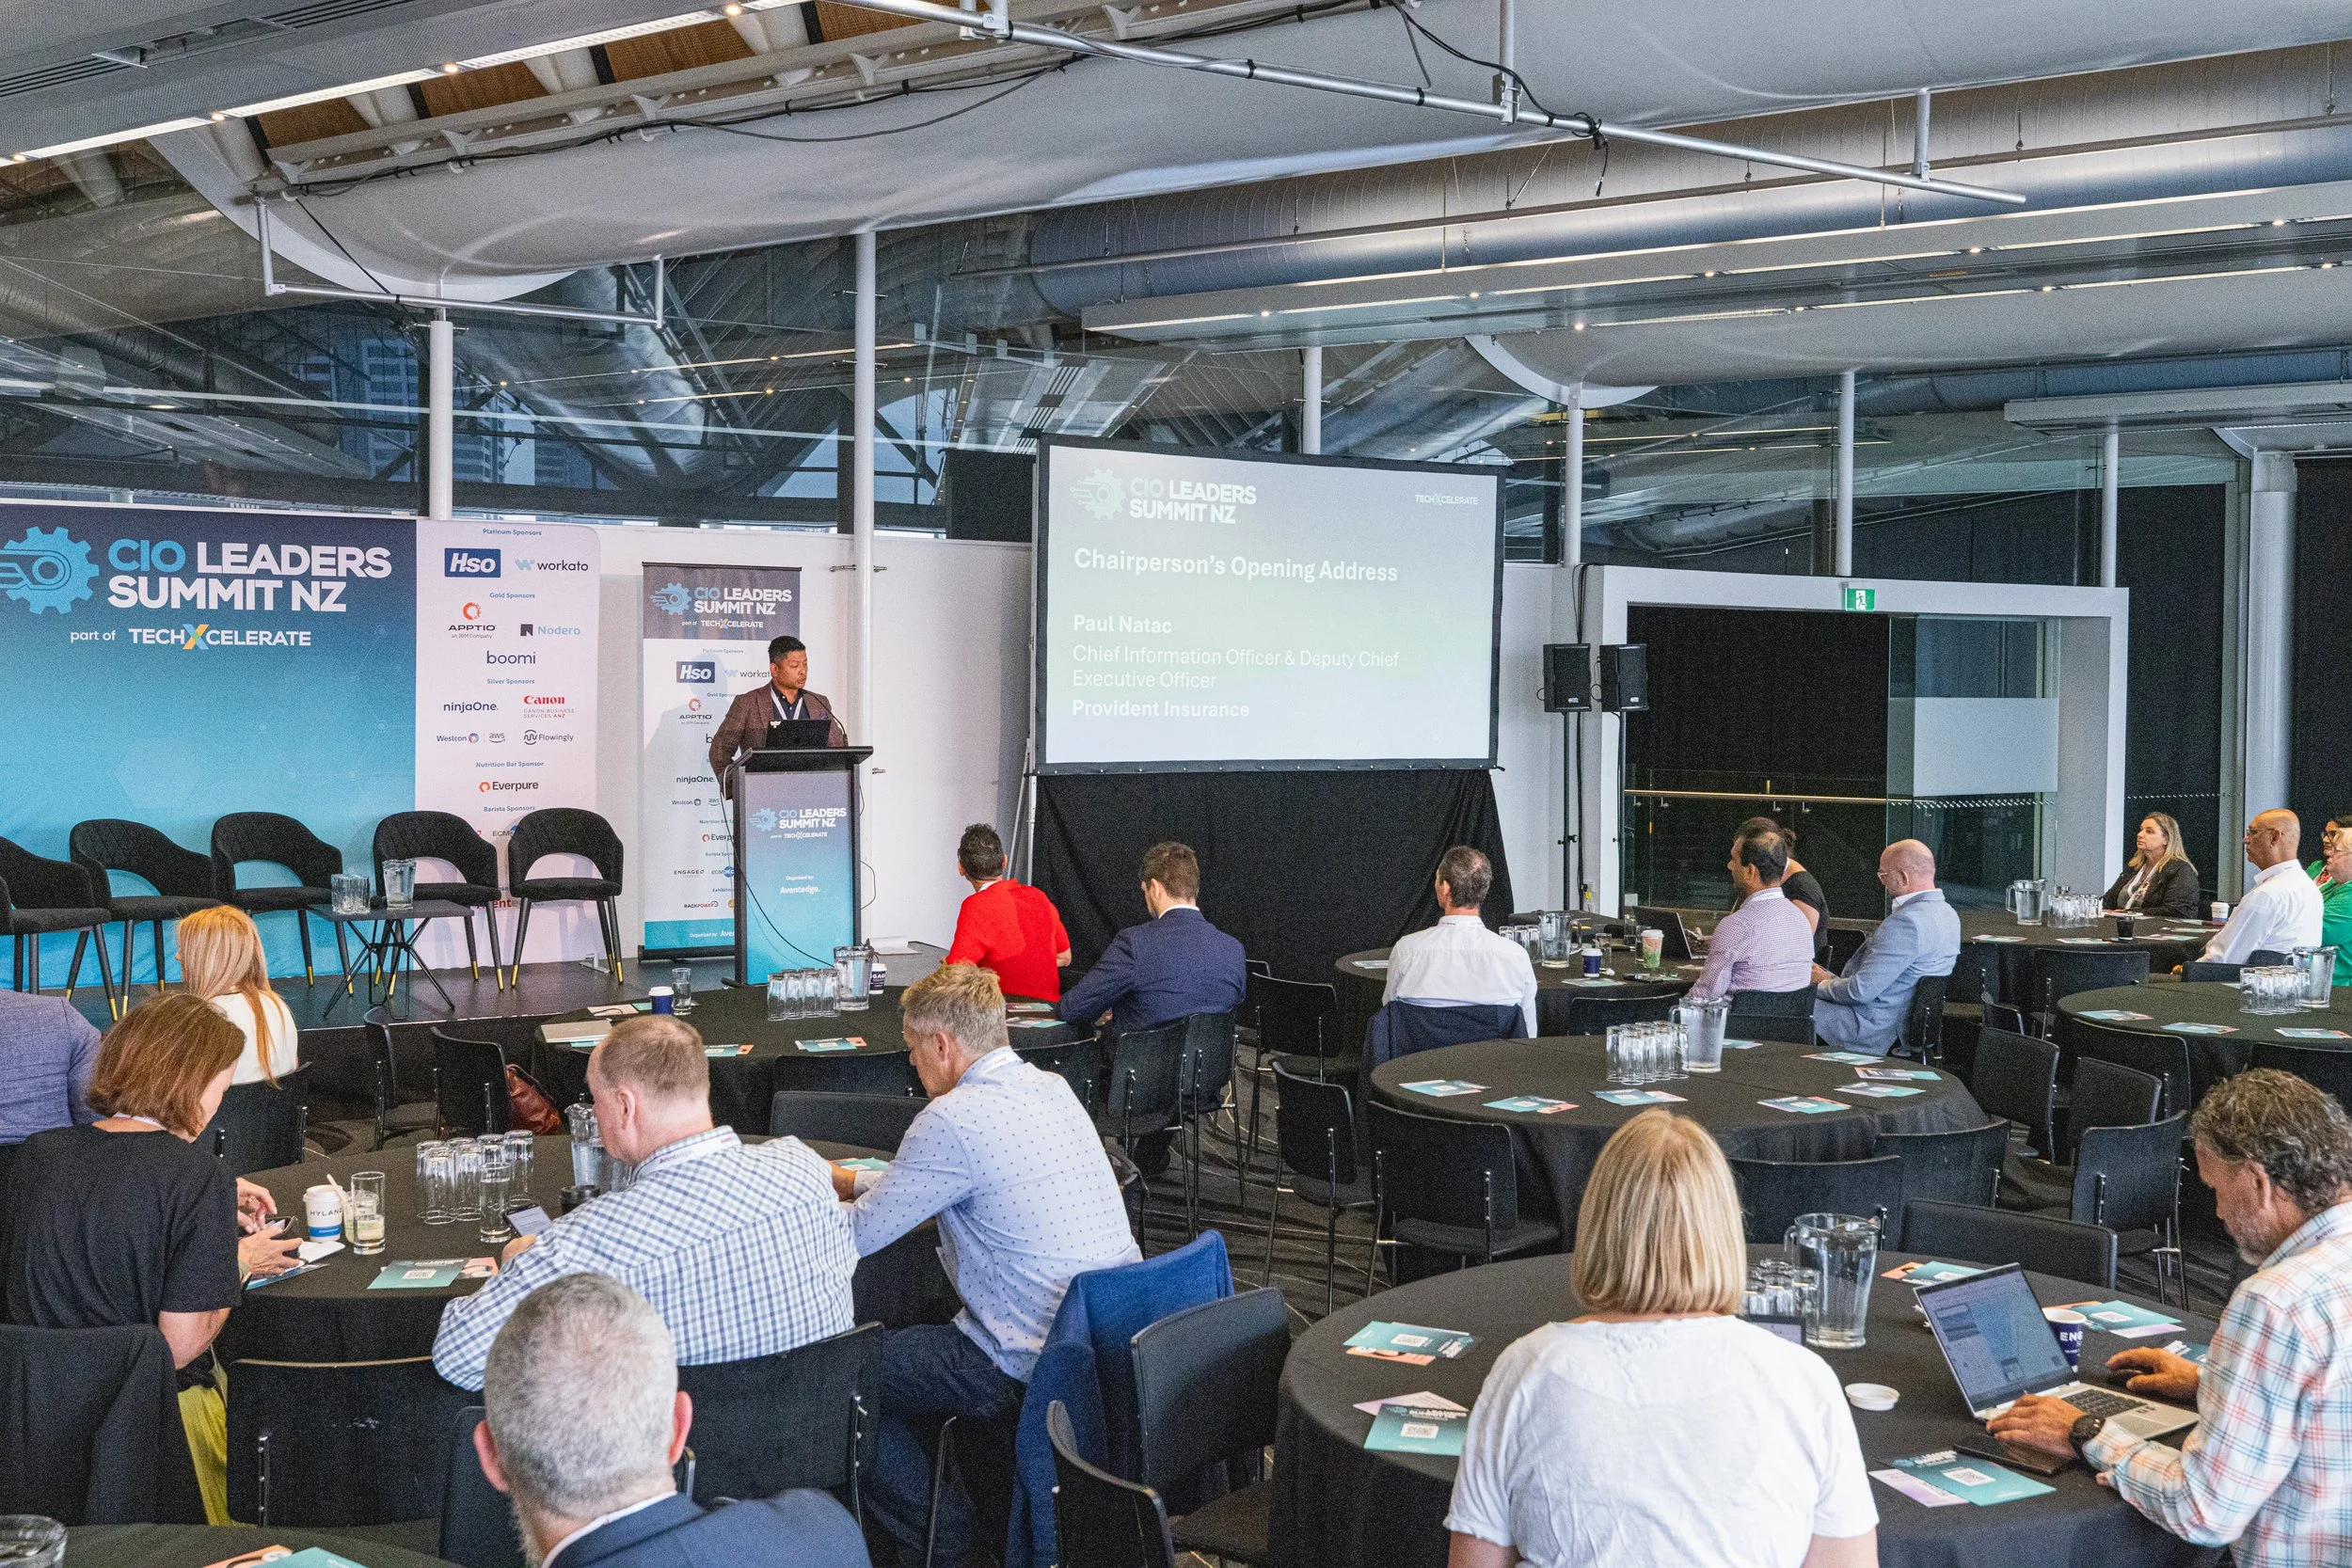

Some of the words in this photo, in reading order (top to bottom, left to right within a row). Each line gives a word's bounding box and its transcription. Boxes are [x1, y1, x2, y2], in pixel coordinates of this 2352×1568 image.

[1130, 478, 1164, 499] CIO
[1168, 480, 1257, 505] LEADERS
[1130, 499, 1209, 522] SUMMIT
[1210, 504, 1236, 524] NZ
[108, 539, 185, 573] CIO
[197, 542, 392, 578] LEADERS
[536, 560, 589, 572] workato
[1232, 556, 1316, 583] Opening
[1319, 559, 1399, 582] Address
[107, 575, 283, 611] SUMMIT
[292, 581, 346, 612] NZ
[694, 587, 721, 600] CIO
[724, 588, 792, 602] LEADERS
[693, 601, 754, 614] SUMMIT
[756, 602, 776, 615] NZ
[537, 626, 580, 636] Nodero
[701, 618, 763, 630] TECHXCELERATE
[1073, 614, 1114, 632] Paul
[1119, 616, 1172, 634] Natac
[70, 629, 99, 644] part
[102, 629, 116, 641] of
[129, 625, 311, 650] TECHXCELERATE
[486, 650, 536, 664] boomi
[1073, 645, 1122, 663] Chief
[1124, 646, 1222, 665] Information
[1226, 648, 1280, 666] Officer
[1285, 650, 1295, 666] &
[1300, 650, 1357, 670] Deputy
[1359, 651, 1400, 667] Chief
[1073, 670, 1155, 688] Executive
[1160, 671, 1216, 689] Officer
[523, 695, 565, 705] Canon
[1072, 700, 1159, 717] Provident
[1165, 701, 1250, 718] Insurance
[538, 734, 574, 742] Flowingly
[492, 781, 539, 792] Everpure
[779, 810, 797, 818] CIO
[800, 808, 847, 818] LEADERS
[779, 818, 820, 829] SUMMIT
[821, 818, 835, 828] NZ
